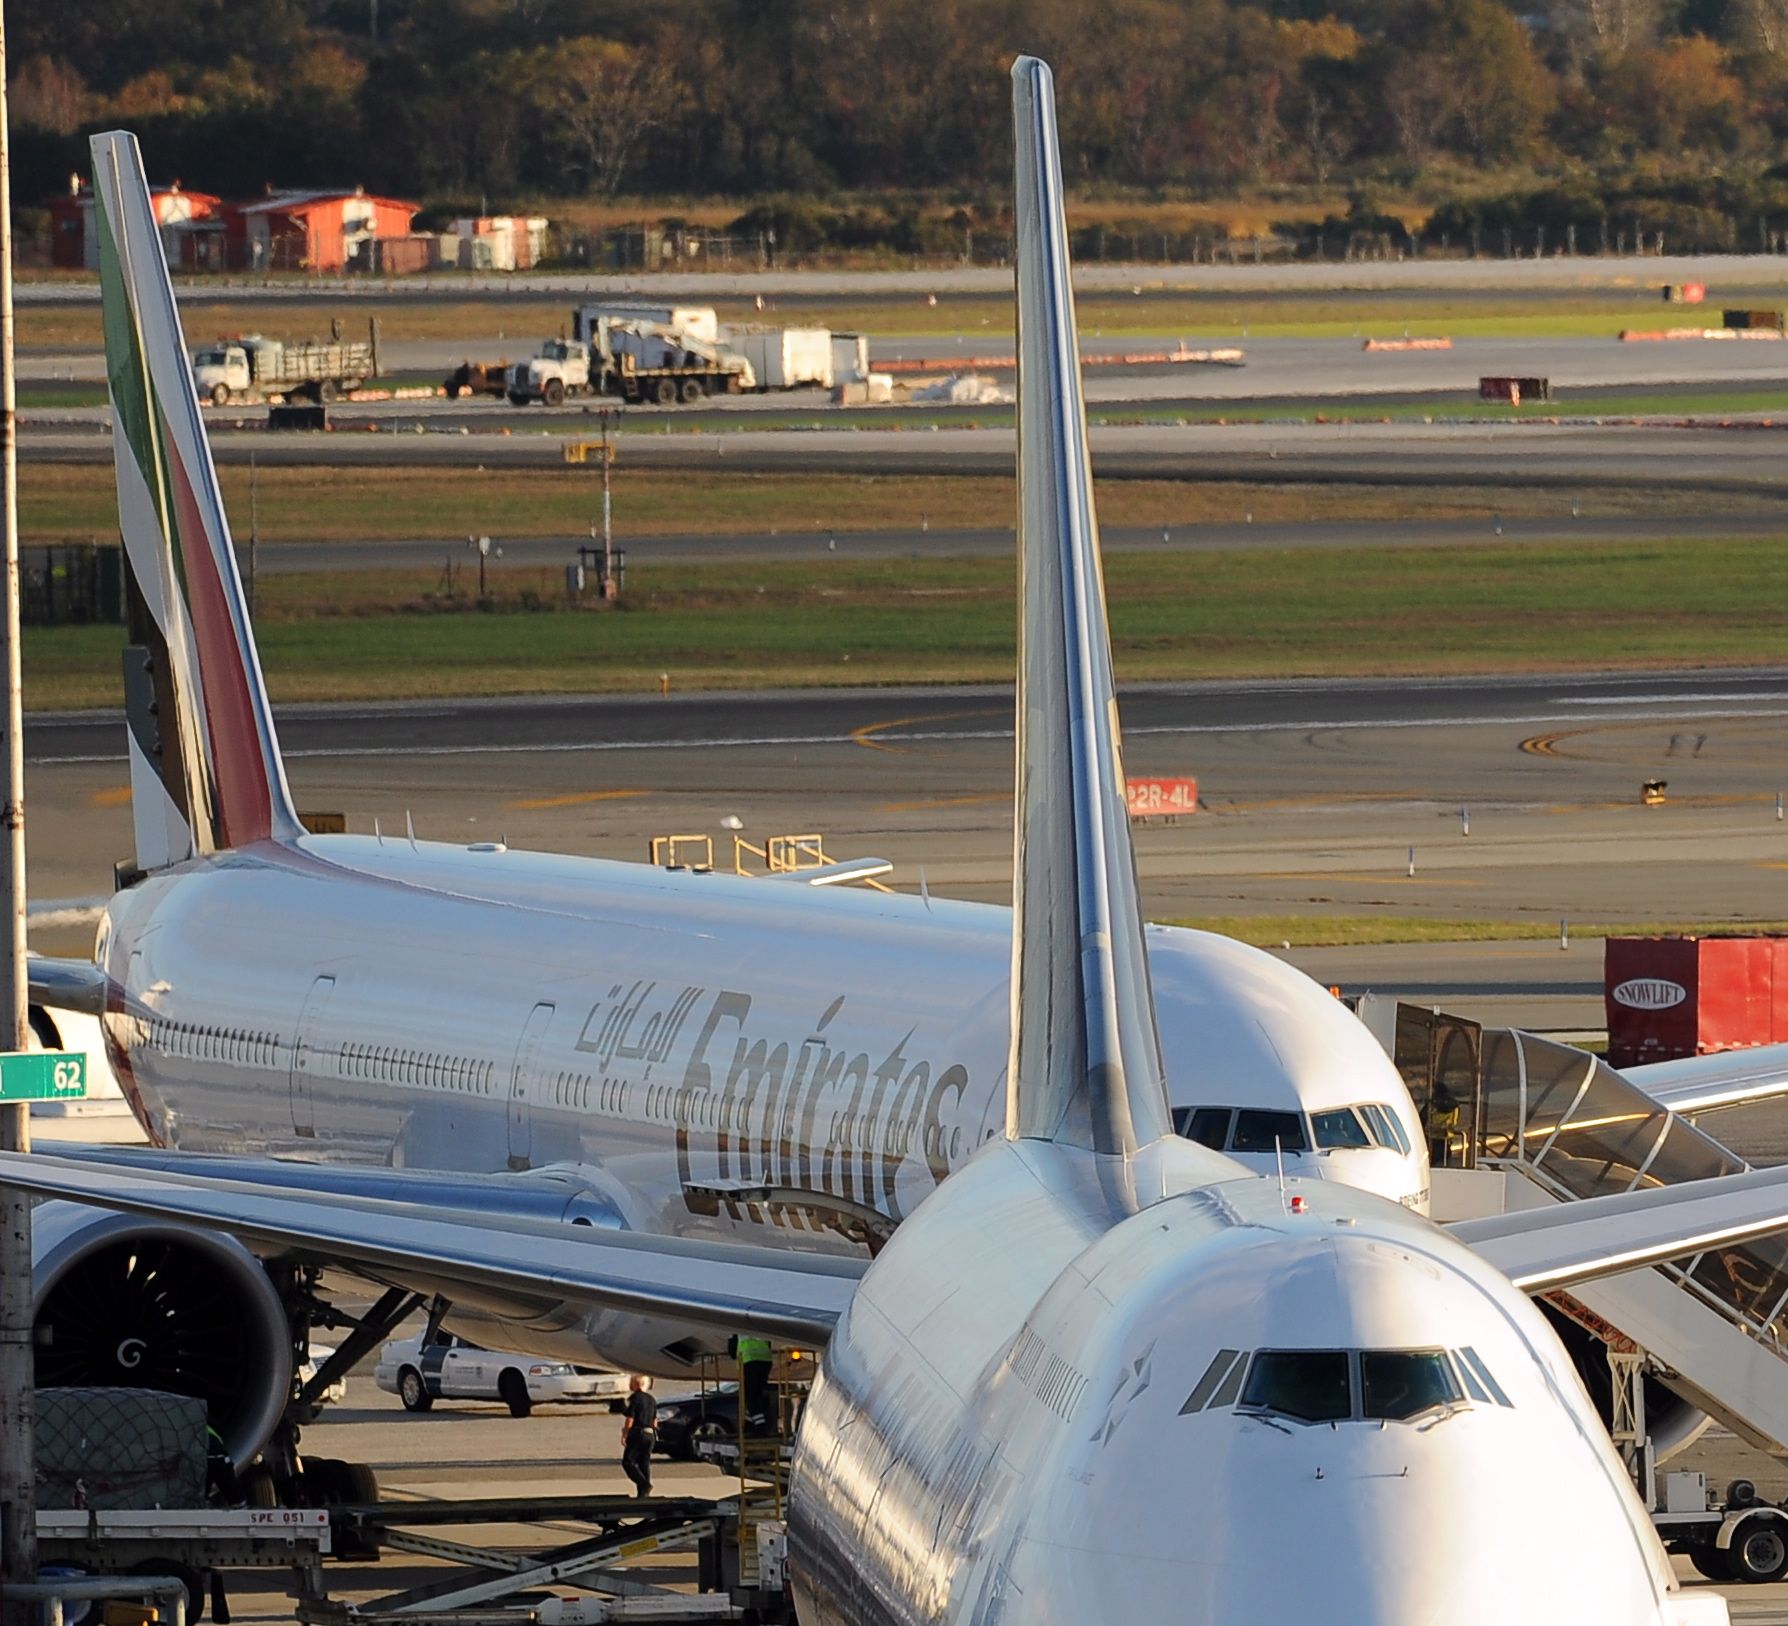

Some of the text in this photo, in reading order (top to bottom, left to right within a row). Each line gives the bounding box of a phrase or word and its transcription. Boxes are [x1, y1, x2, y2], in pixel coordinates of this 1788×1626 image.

[1617, 983, 1680, 1005] SNOWLIFT
[53, 1061, 82, 1091] 62
[674, 990, 969, 1234] Emirates
[250, 1512, 274, 1524] SPE
